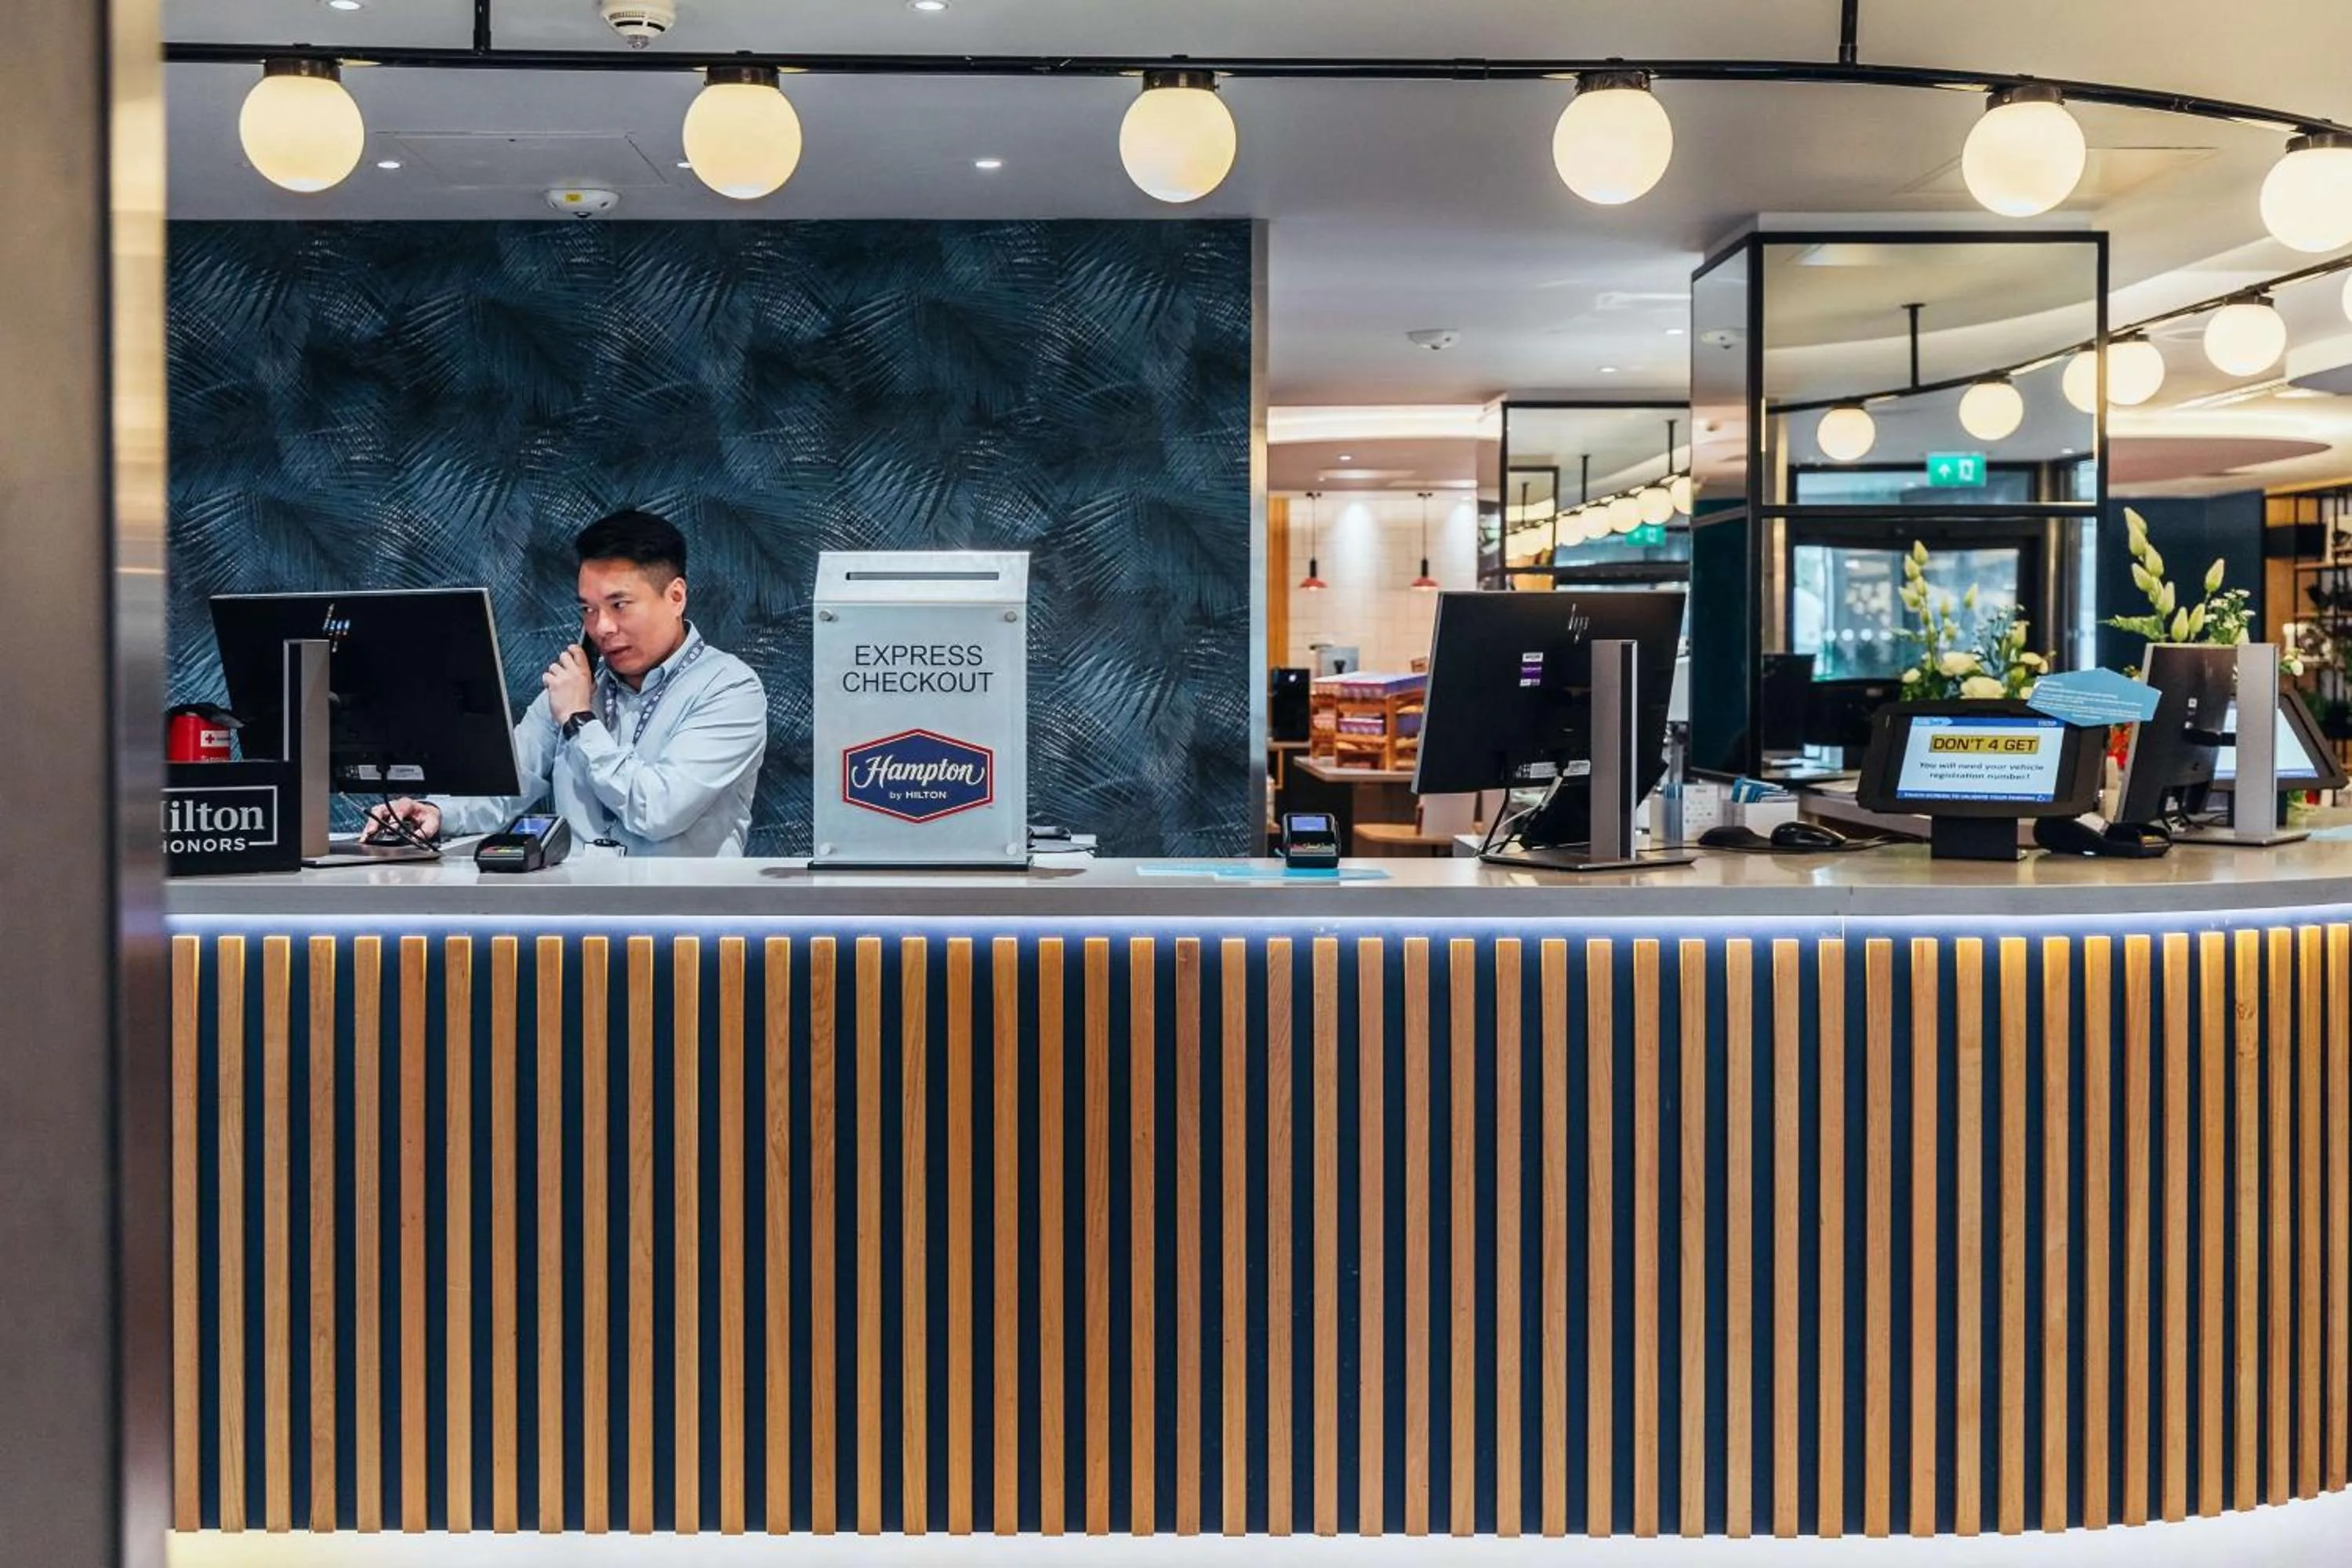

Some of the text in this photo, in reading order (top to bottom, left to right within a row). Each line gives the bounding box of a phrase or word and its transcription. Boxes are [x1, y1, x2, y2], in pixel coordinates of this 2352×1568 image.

[855, 644, 983, 666] EXPRESS
[842, 671, 994, 692] CHECKOUT
[1933, 738, 2037, 751] DON'T 4 GET
[851, 754, 985, 788] Hampton
[889, 790, 947, 800] by HILTON
